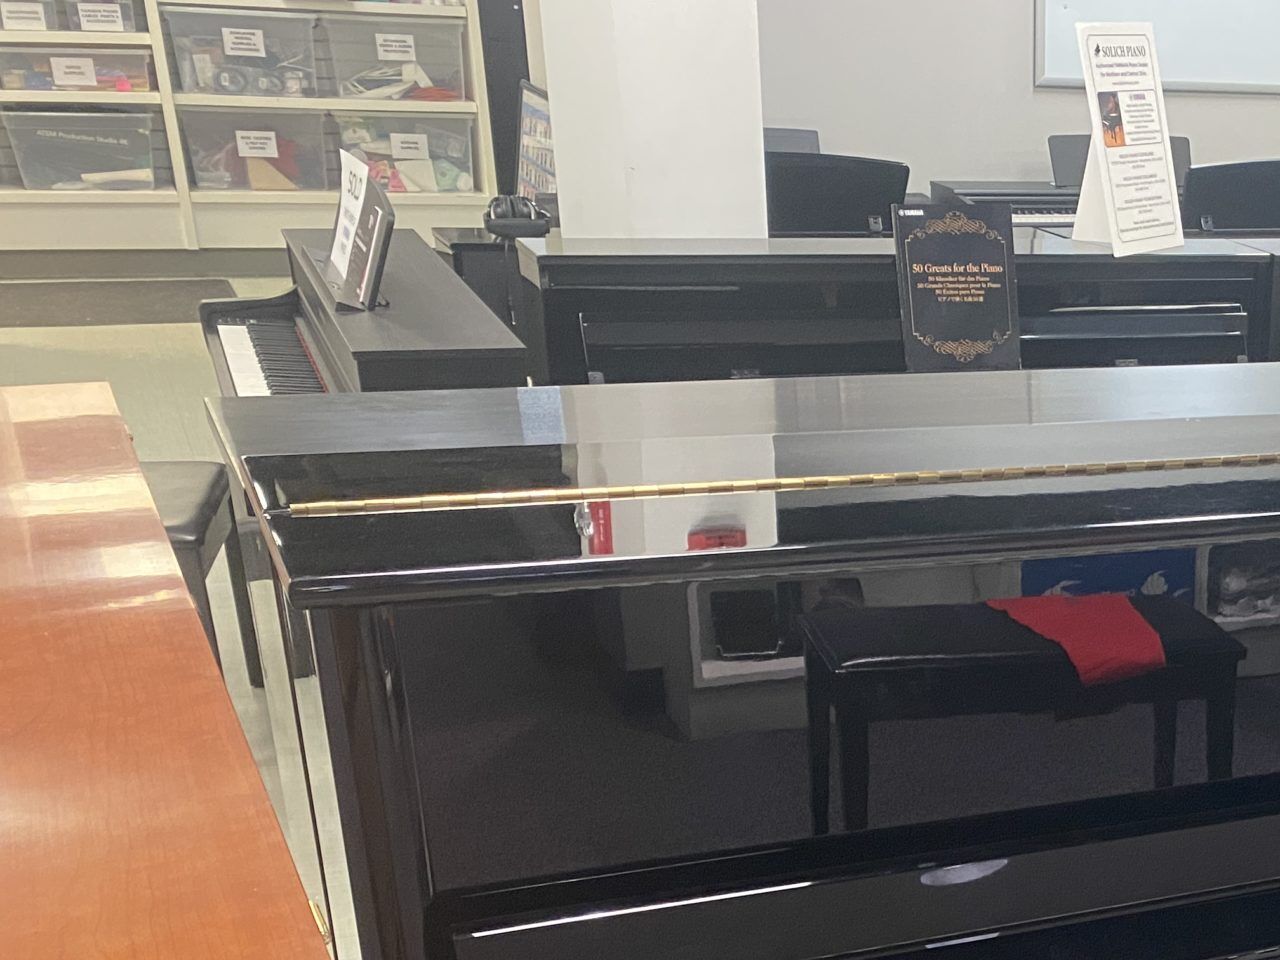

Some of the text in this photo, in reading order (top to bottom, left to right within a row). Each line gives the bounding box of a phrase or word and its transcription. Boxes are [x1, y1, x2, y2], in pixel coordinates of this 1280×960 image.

[1101, 45, 1146, 58] SOLICH PIANO
[347, 170, 363, 201] SOLD
[912, 262, 1003, 274] 50 Greats for the Piano
